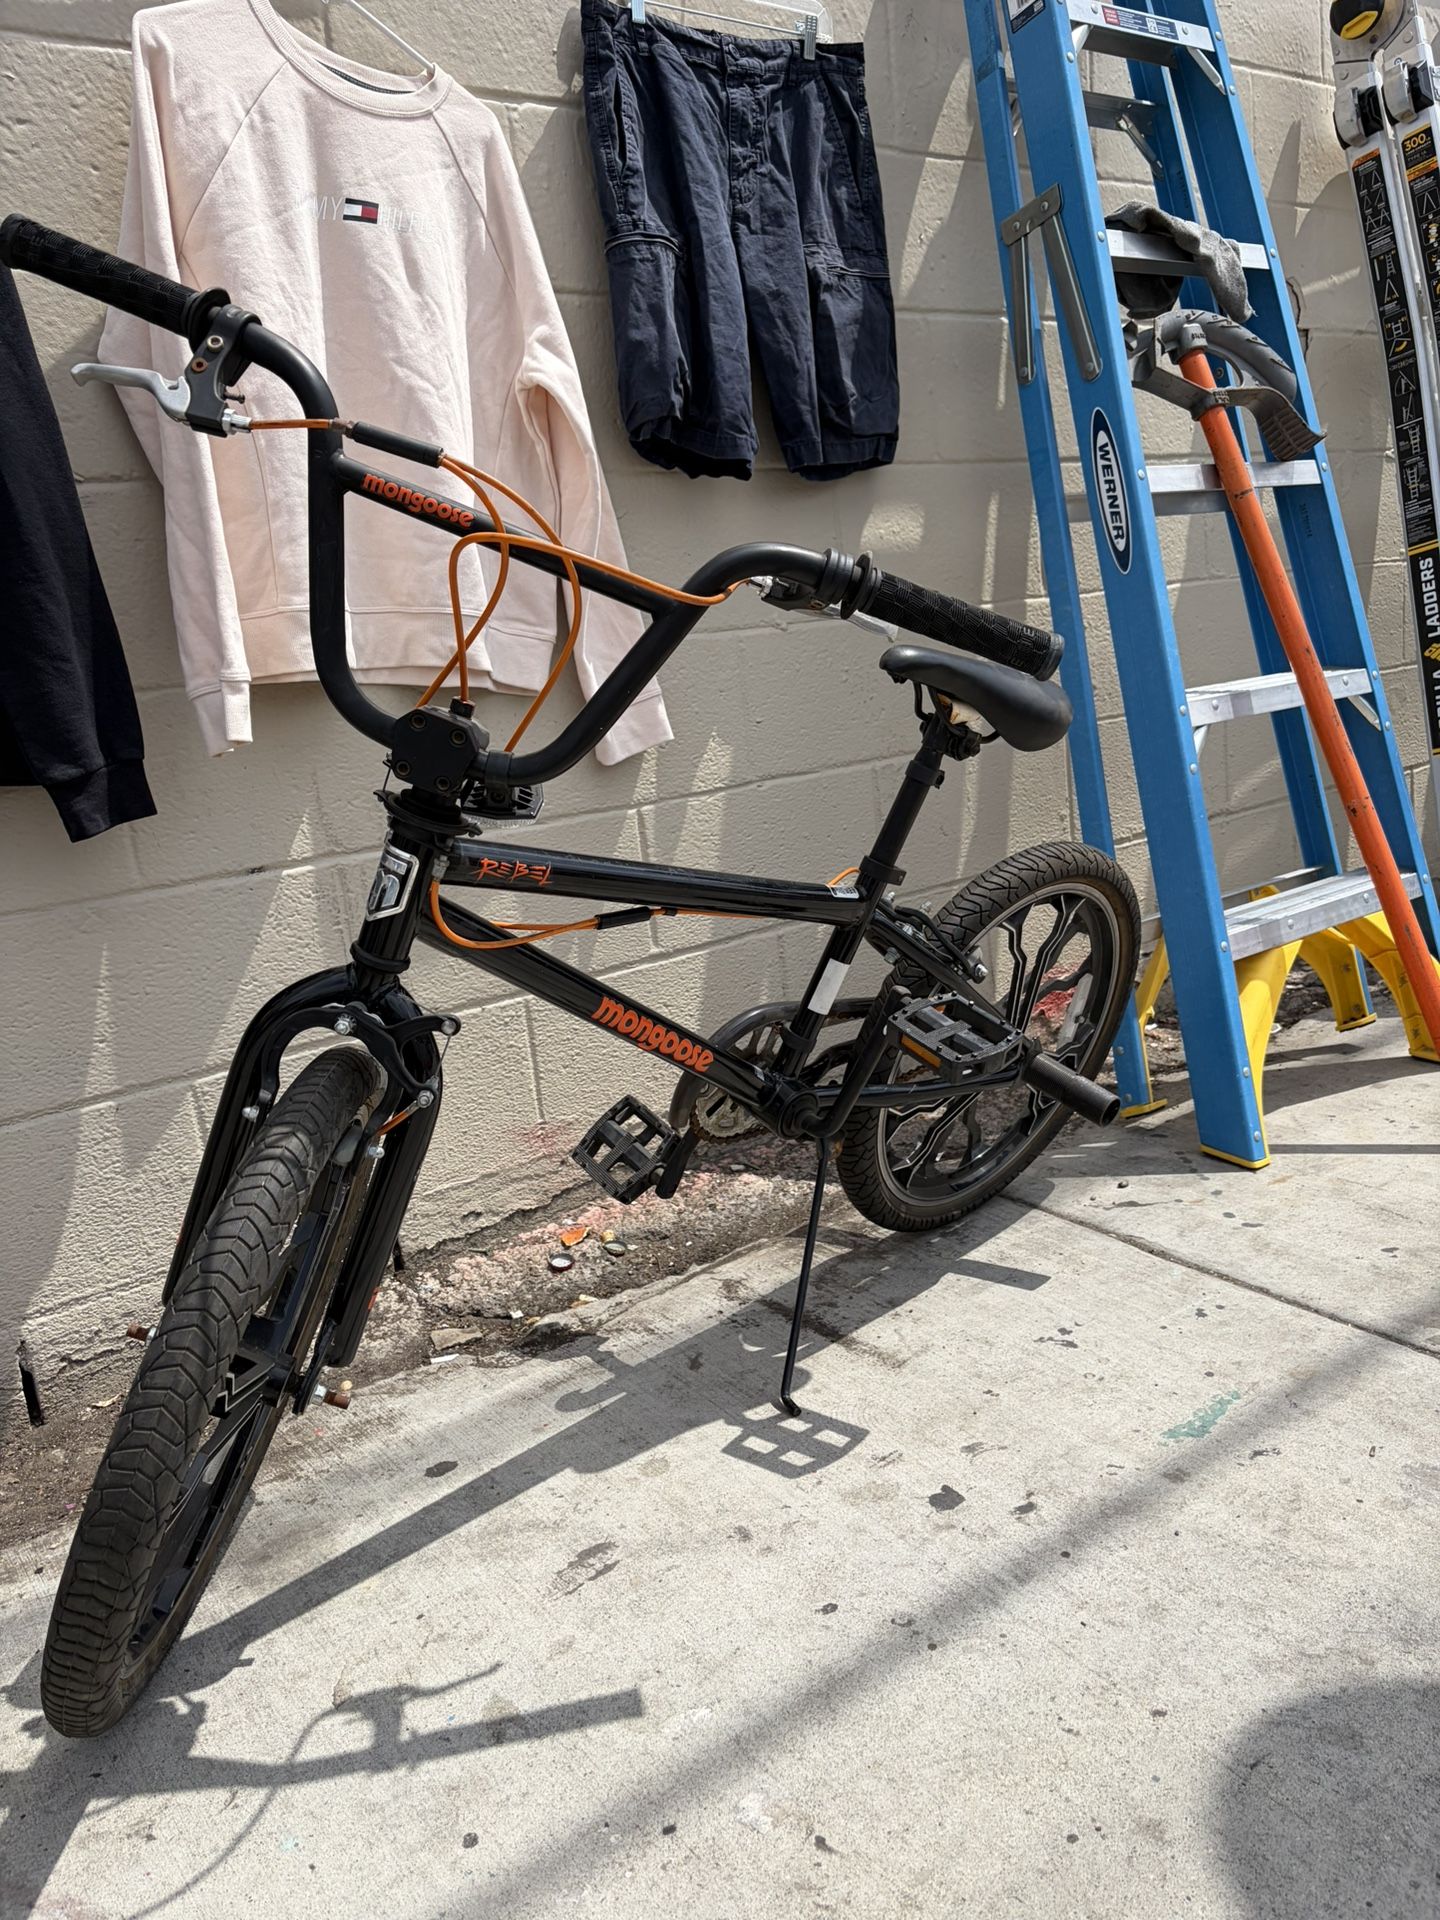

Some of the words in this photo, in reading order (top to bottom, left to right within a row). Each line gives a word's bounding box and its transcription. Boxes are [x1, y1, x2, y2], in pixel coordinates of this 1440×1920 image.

[1404, 133, 1426, 151] 300
[361, 473, 475, 527] mongoose
[1098, 442, 1125, 541] WERNER
[1419, 557, 1440, 638] LADDERS
[470, 857, 554, 887] REBEL
[592, 996, 714, 1073] mongoose
